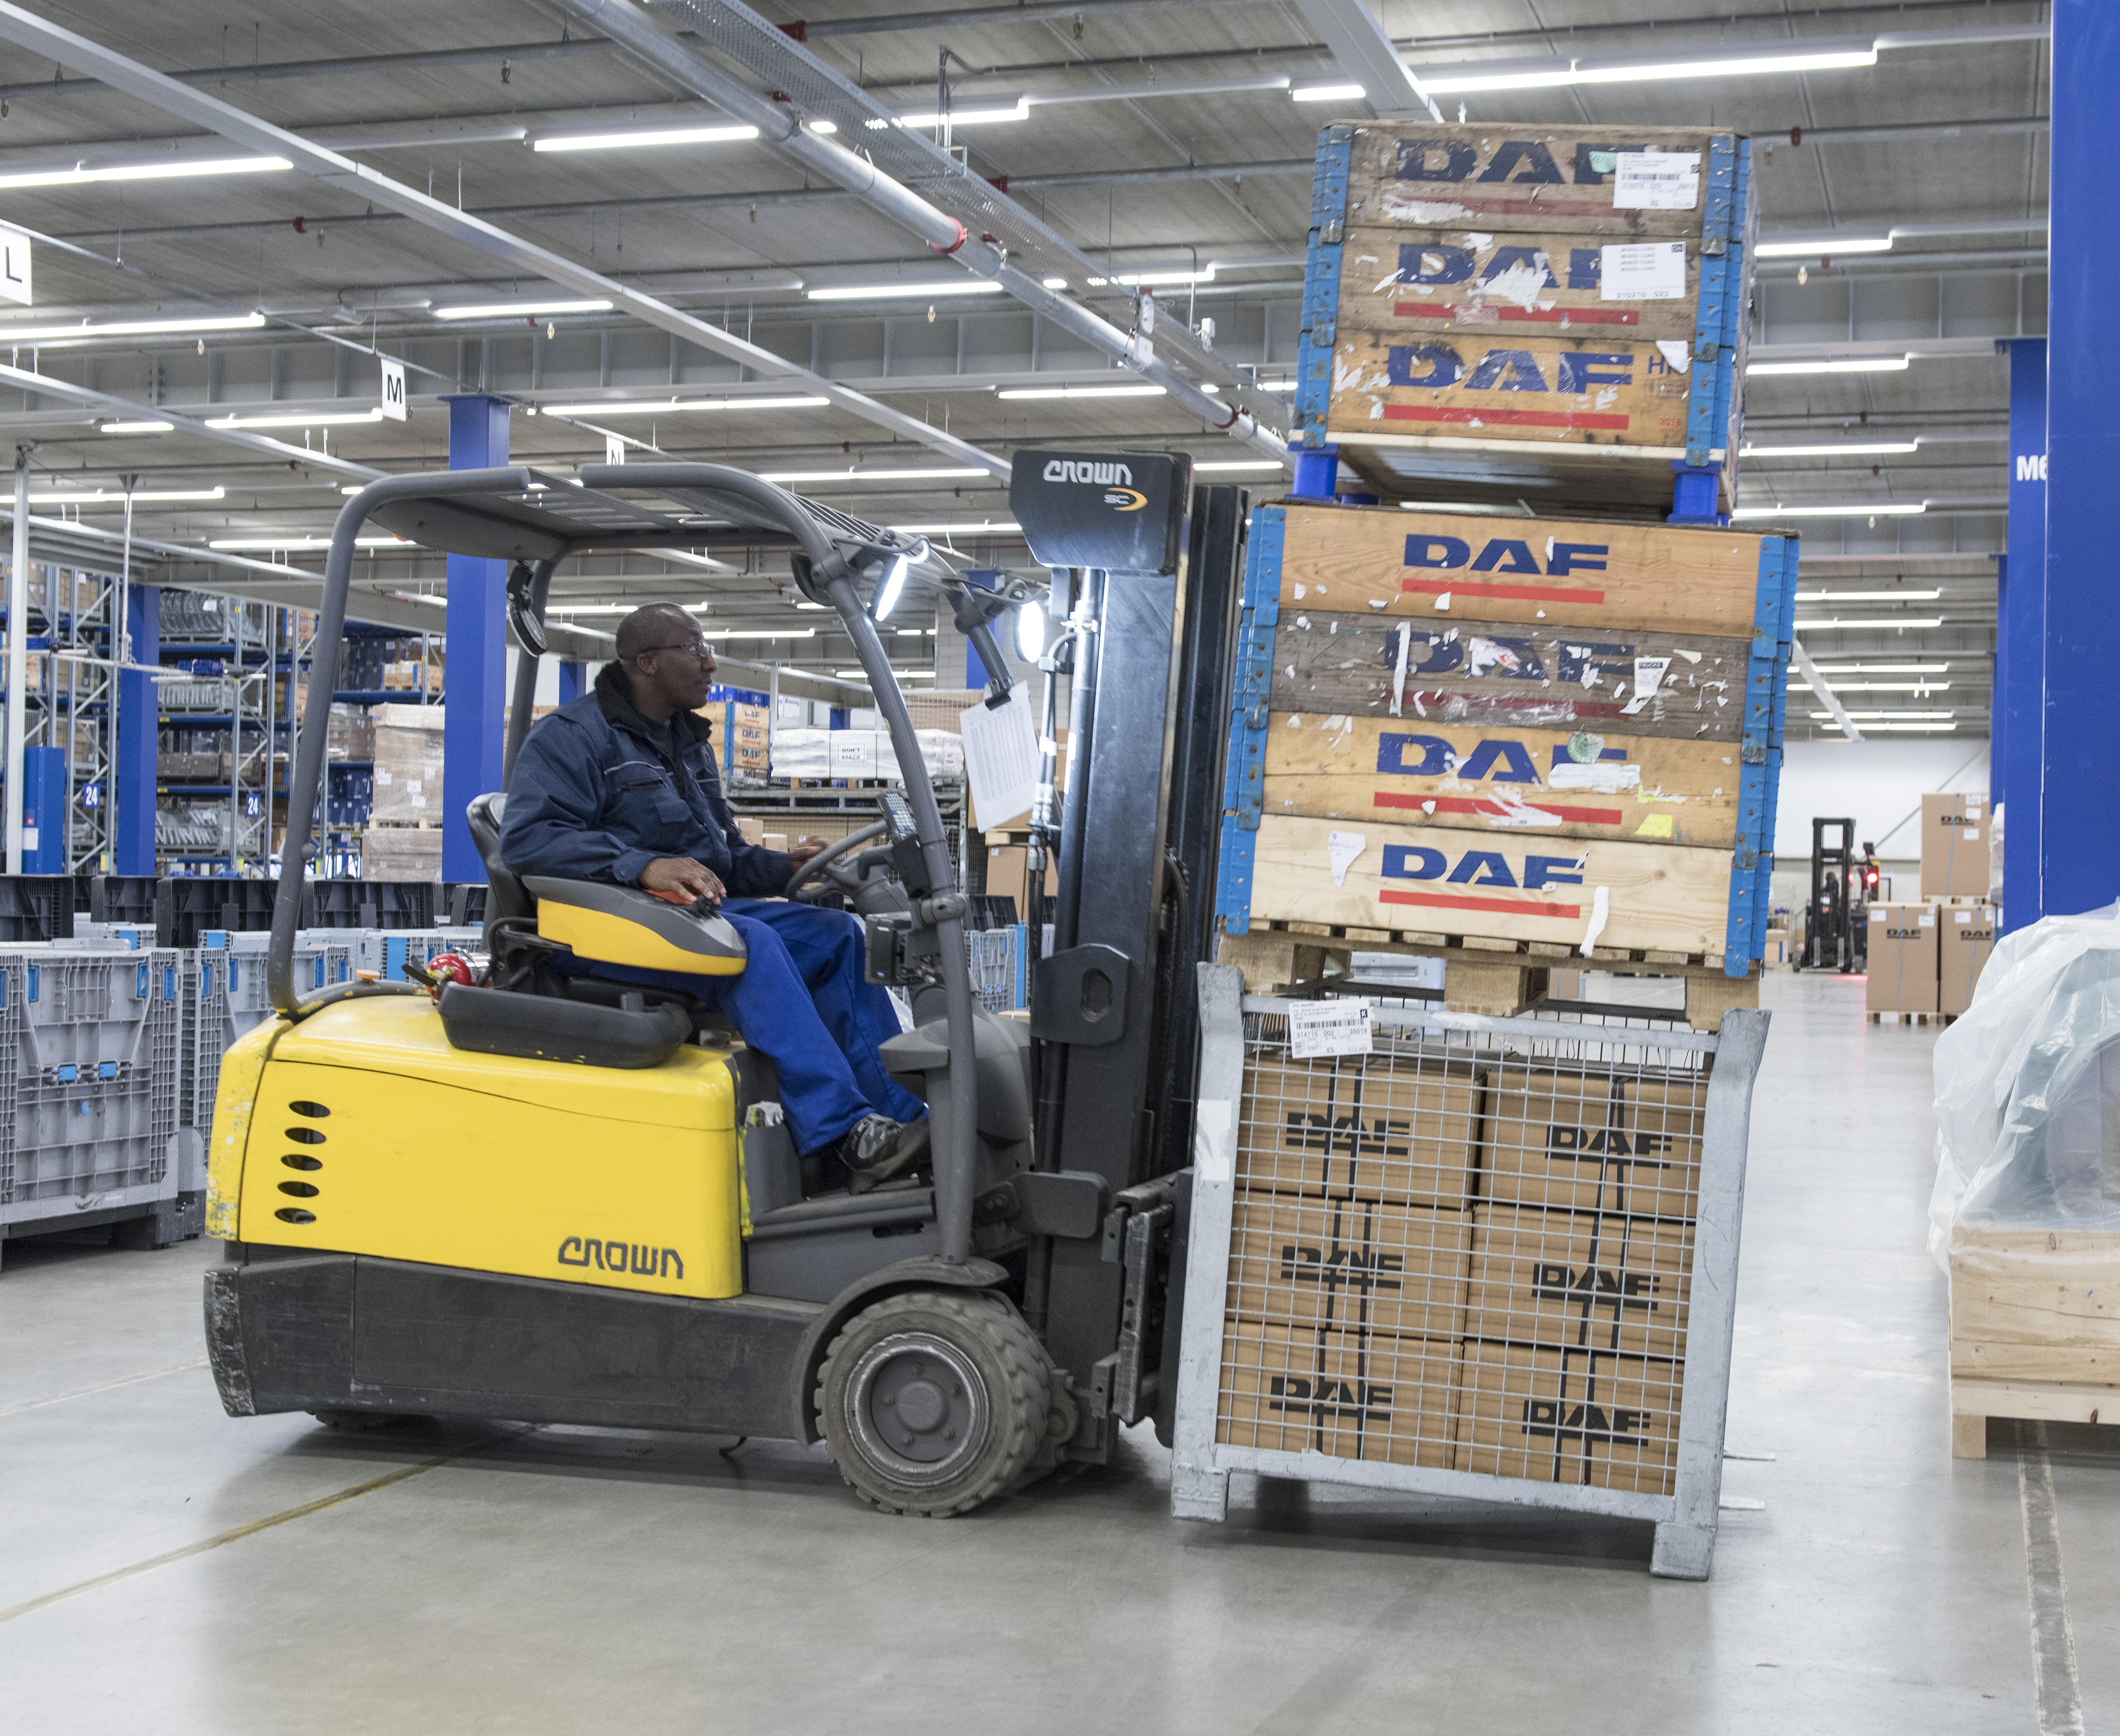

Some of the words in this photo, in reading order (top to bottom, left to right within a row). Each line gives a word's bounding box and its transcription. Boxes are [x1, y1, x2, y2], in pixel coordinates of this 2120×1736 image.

[5, 246, 22, 283] L
[1386, 345, 1634, 393] DAF
[387, 374, 402, 404] M
[1043, 460, 1133, 486] CROWN
[1404, 534, 1609, 576] DAF
[743, 729, 760, 739] DAF
[86, 785, 98, 805] 24
[248, 796, 258, 816] 24
[1380, 844, 1584, 890] DAF
[1286, 1113, 1410, 1142] DAF
[1546, 1125, 1672, 1156] DAF
[558, 1236, 683, 1279] CROWN
[1281, 1245, 1405, 1275] DAF
[1533, 1263, 1660, 1297] DAF
[1271, 1376, 1393, 1407] DAF
[1523, 1400, 1650, 1434] DAF
